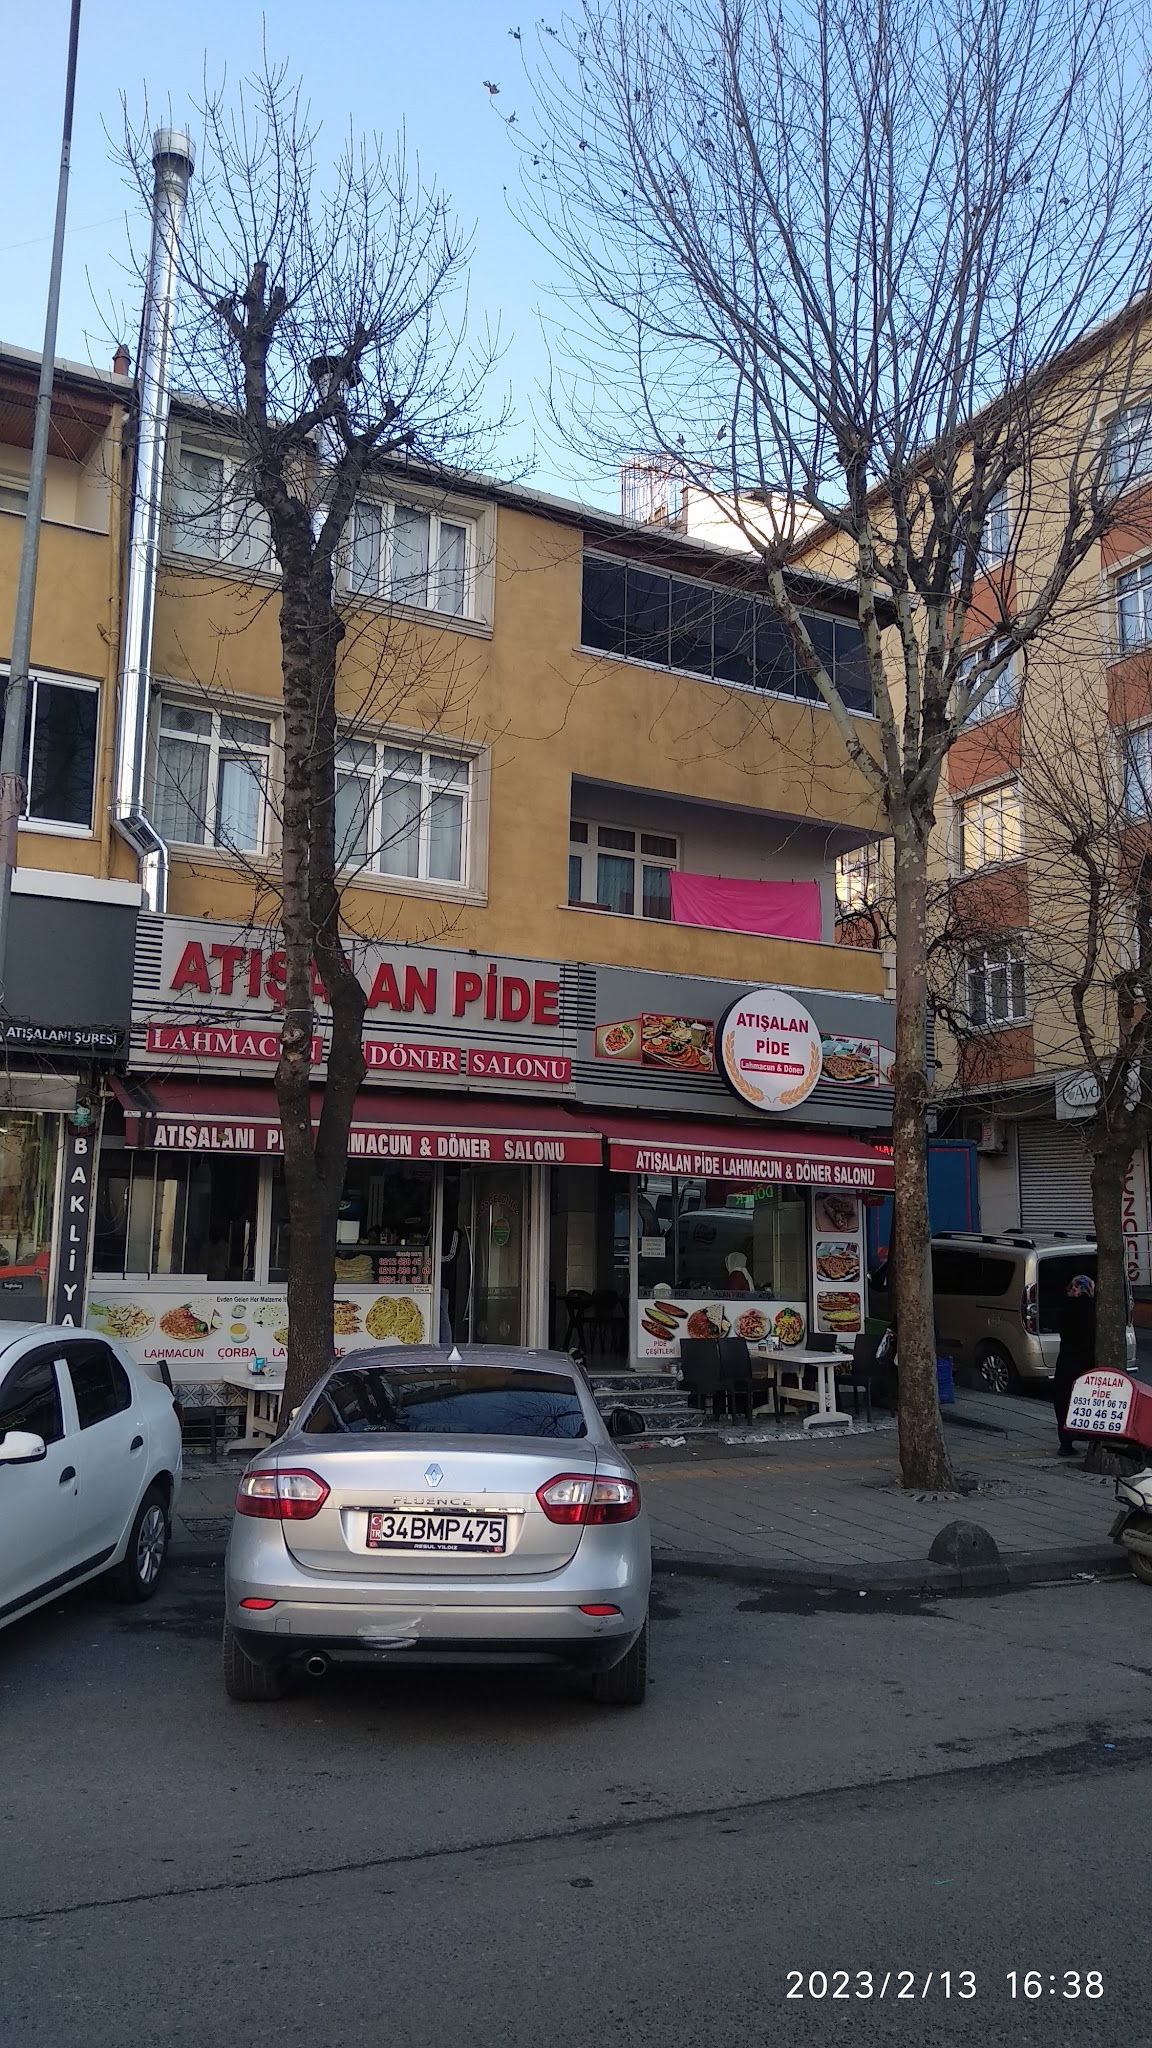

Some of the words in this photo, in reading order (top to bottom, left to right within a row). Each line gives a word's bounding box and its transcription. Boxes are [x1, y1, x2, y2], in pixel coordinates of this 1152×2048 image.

[452, 963, 561, 1026] PİDE
[736, 1012, 809, 1033] ATIŞALAN
[6, 1026, 71, 1041] ATIŞALANI
[756, 1037, 790, 1056] PİDE
[369, 1043, 459, 1071] DÖNER
[472, 1054, 567, 1080] SALONU
[741, 1060, 775, 1072] Lahmacun
[776, 1064, 782, 1072] &
[783, 1064, 804, 1075] Döner
[153, 1124, 255, 1150] ATIŞALANI
[420, 1137, 432, 1156] &
[437, 1133, 491, 1159] DÖNER
[504, 1139, 565, 1162] SALONU
[636, 1150, 691, 1173] ATIŞALAN
[695, 1152, 720, 1175] PİDE
[722, 1156, 782, 1179] LAHMACUN
[785, 1164, 793, 1179] &
[797, 1159, 832, 1183] DÖNER
[834, 1165, 875, 1186] SALONU
[653, 1339, 667, 1347] PİDE
[144, 1349, 204, 1358] LAHMACUN
[218, 1347, 257, 1360] ÇORBA
[1084, 1376, 1124, 1388] ATIŞALAN
[1091, 1389, 1111, 1399] PİDE
[1073, 1397, 1091, 1406] 0531
[1092, 1399, 1105, 1407] 501
[1107, 1400, 1116, 1408] 06
[1118, 1401, 1127, 1409] 78
[1072, 1407, 1092, 1417] 430
[1095, 1409, 1107, 1418] 46
[1110, 1411, 1124, 1420] 54
[1071, 1418, 1090, 1428] 430
[1093, 1420, 1105, 1430] 65
[1108, 1422, 1121, 1431] 69
[392, 1495, 472, 1505] FLUENCE
[371, 1529, 381, 1538] TR
